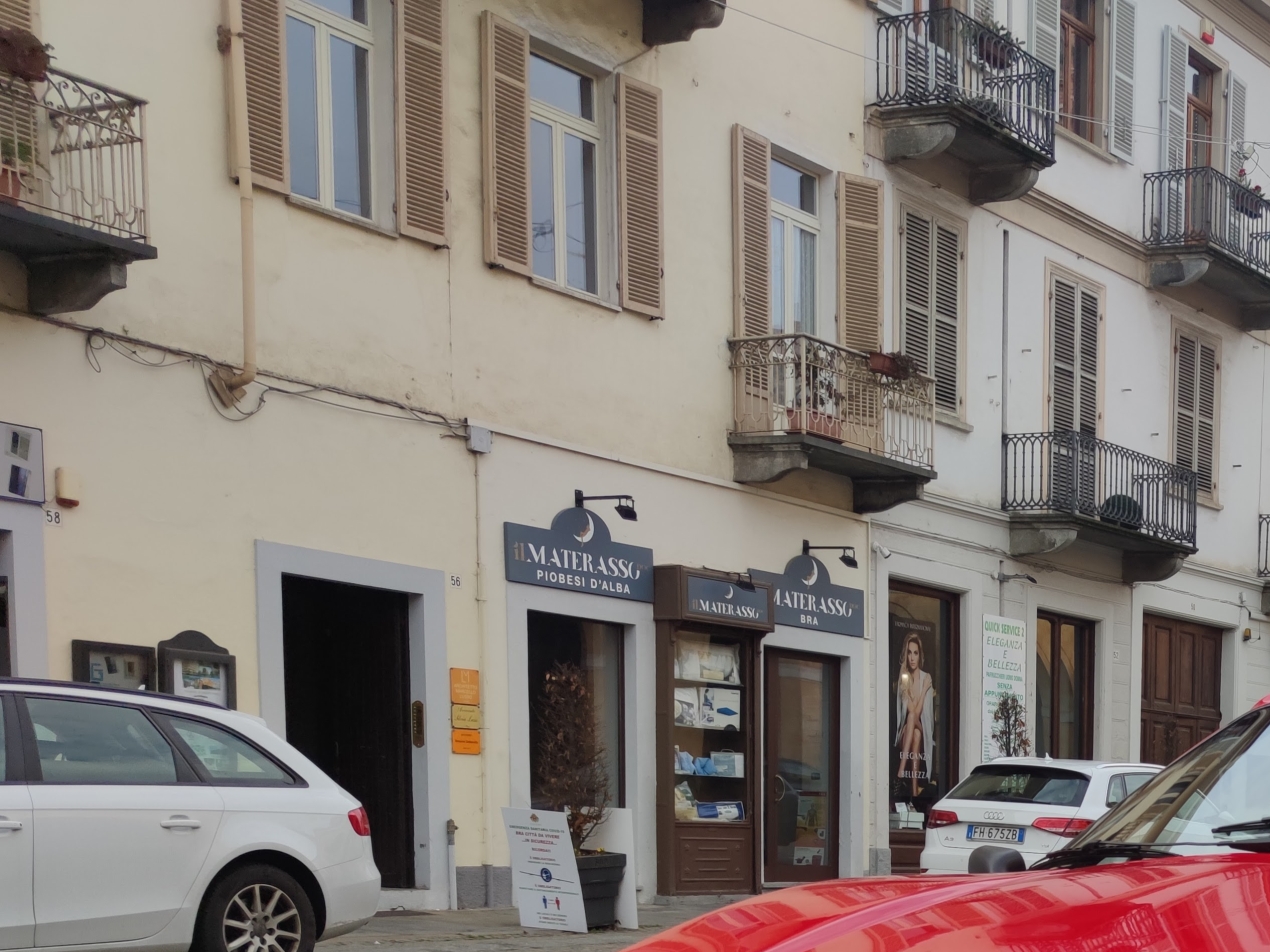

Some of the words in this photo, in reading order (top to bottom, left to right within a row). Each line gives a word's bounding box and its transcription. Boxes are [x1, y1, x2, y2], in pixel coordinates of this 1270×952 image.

[46, 510, 61, 524] 58
[526, 542, 640, 580] MATERASSO
[451, 575, 460, 586] 56
[536, 569, 585, 587] PIOBESI
[590, 578, 631, 594] D'ALBA
[698, 599, 759, 619] MATERASSO
[800, 614, 819, 626] BRA
[984, 620, 1000, 634] QUICK
[1001, 623, 1020, 637] SERVICE
[1021, 627, 1025, 637] 2
[986, 636, 1023, 650] ELEGANZA
[1003, 650, 1008, 659] E
[987, 659, 1022, 672] BELLEZZA
[997, 682, 1013, 690] SENZA
[987, 828, 1018, 840] 675ZB
